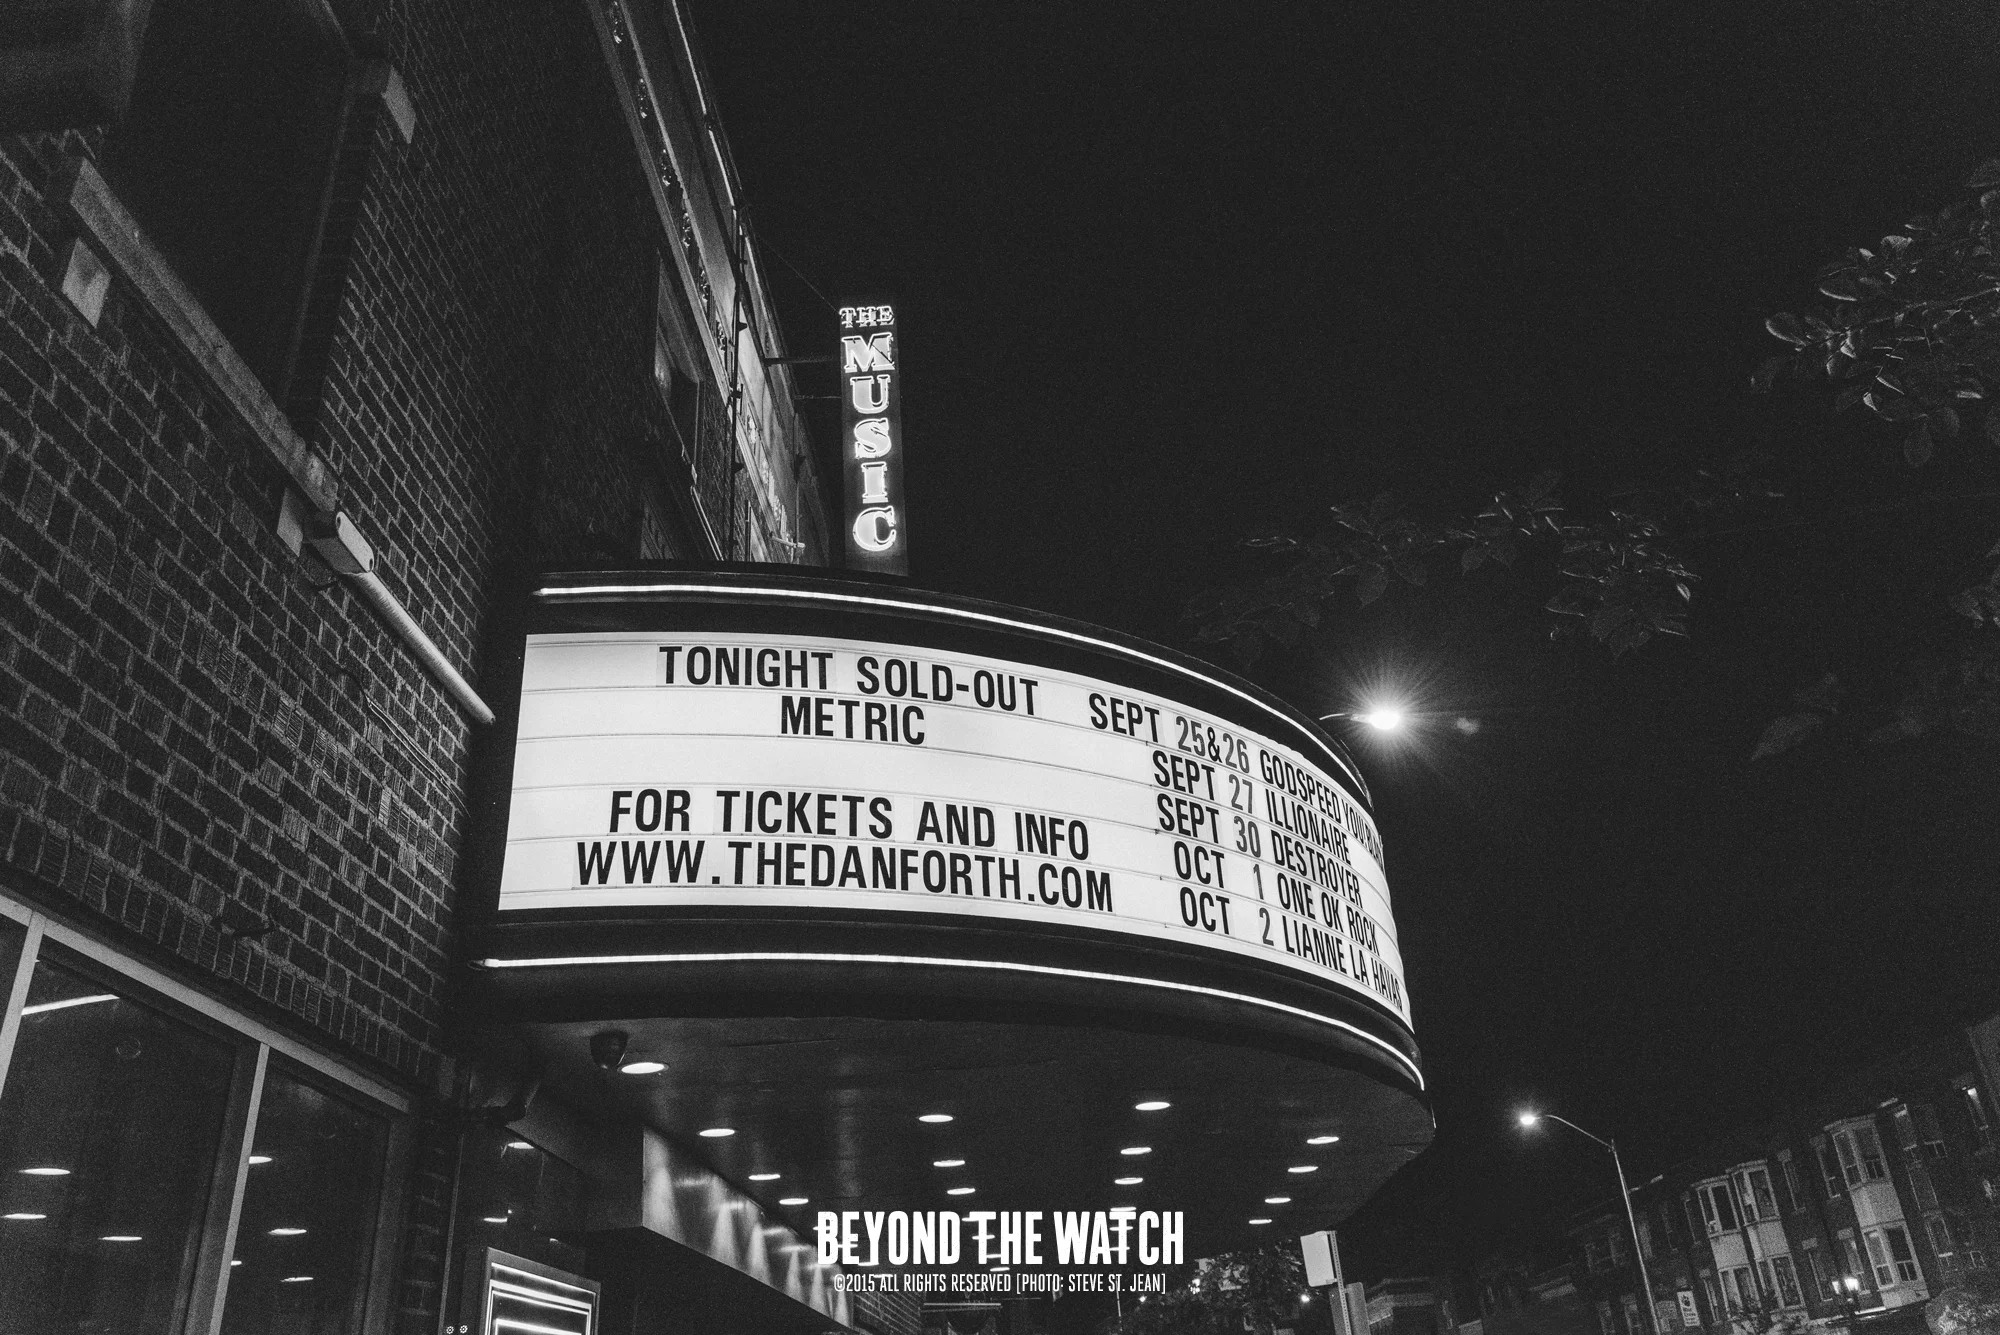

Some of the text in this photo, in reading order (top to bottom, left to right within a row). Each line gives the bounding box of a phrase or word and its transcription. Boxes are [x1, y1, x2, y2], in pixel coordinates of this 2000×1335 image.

[839, 306, 895, 328] THE
[841, 332, 897, 551] MUSIC
[659, 646, 1039, 716] TONIGHT SOLD-OUT
[781, 696, 925, 745] METRIC
[1089, 693, 1160, 743] SEPT
[1175, 716, 1250, 774] 25&26
[1260, 749, 1342, 824] GODSPEED
[1152, 750, 1216, 800] SEPT
[1228, 774, 1253, 814] 27
[1265, 789, 1351, 866] ILLIONAIRE
[609, 789, 1089, 861] FOR TICKETS AND INFO
[1157, 794, 1220, 844] SEPT
[1233, 816, 1262, 858] 30
[1271, 830, 1363, 908] DESTROYER
[577, 840, 1113, 913] WWW.THEDANFORTH.COM
[1174, 841, 1380, 956] OCT 1 ONE OK ROCK
[1180, 887, 1230, 935] OCT
[1259, 908, 1274, 946] 2
[1282, 916, 1348, 974] LIANNE
[1350, 944, 1369, 986] LA
